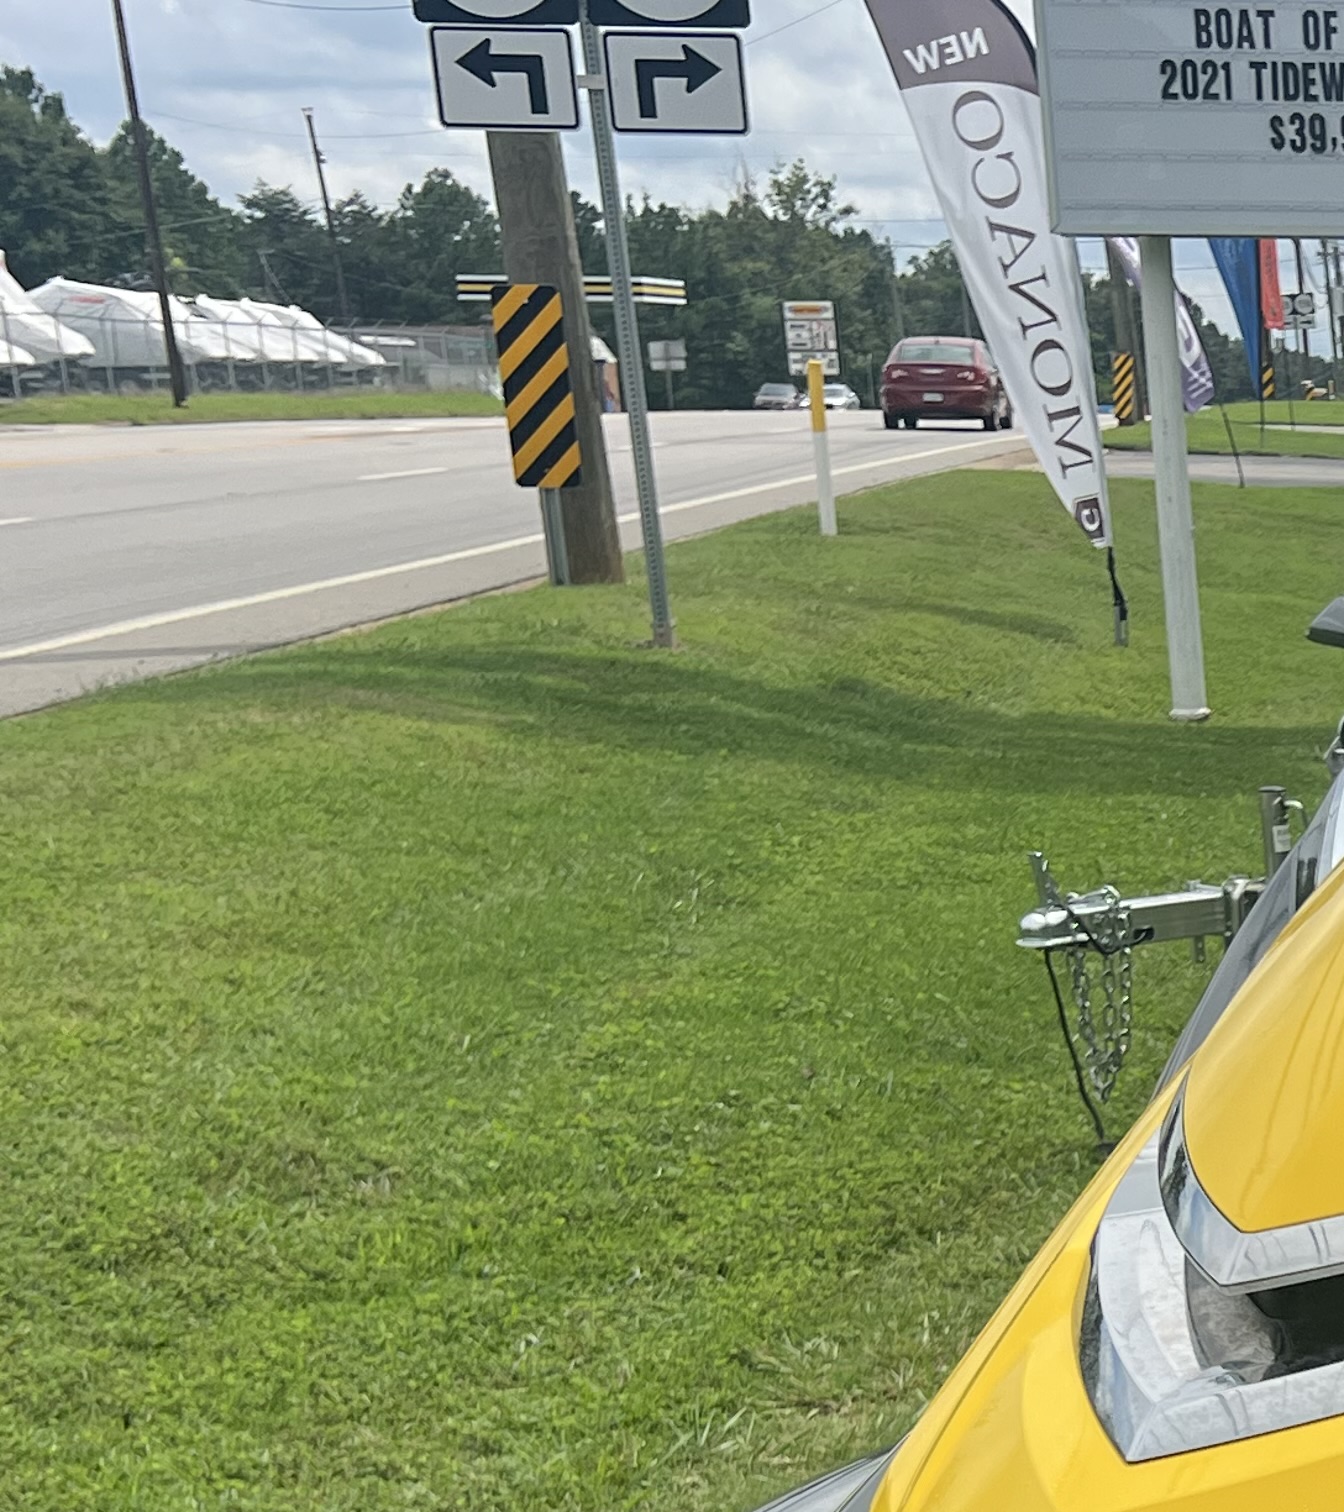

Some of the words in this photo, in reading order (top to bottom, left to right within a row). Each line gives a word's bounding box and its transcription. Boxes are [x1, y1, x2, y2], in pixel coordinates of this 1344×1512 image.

[1193, 8, 1275, 51] BOAT
[1303, 9, 1338, 53] OF
[1159, 59, 1233, 102] 2021
